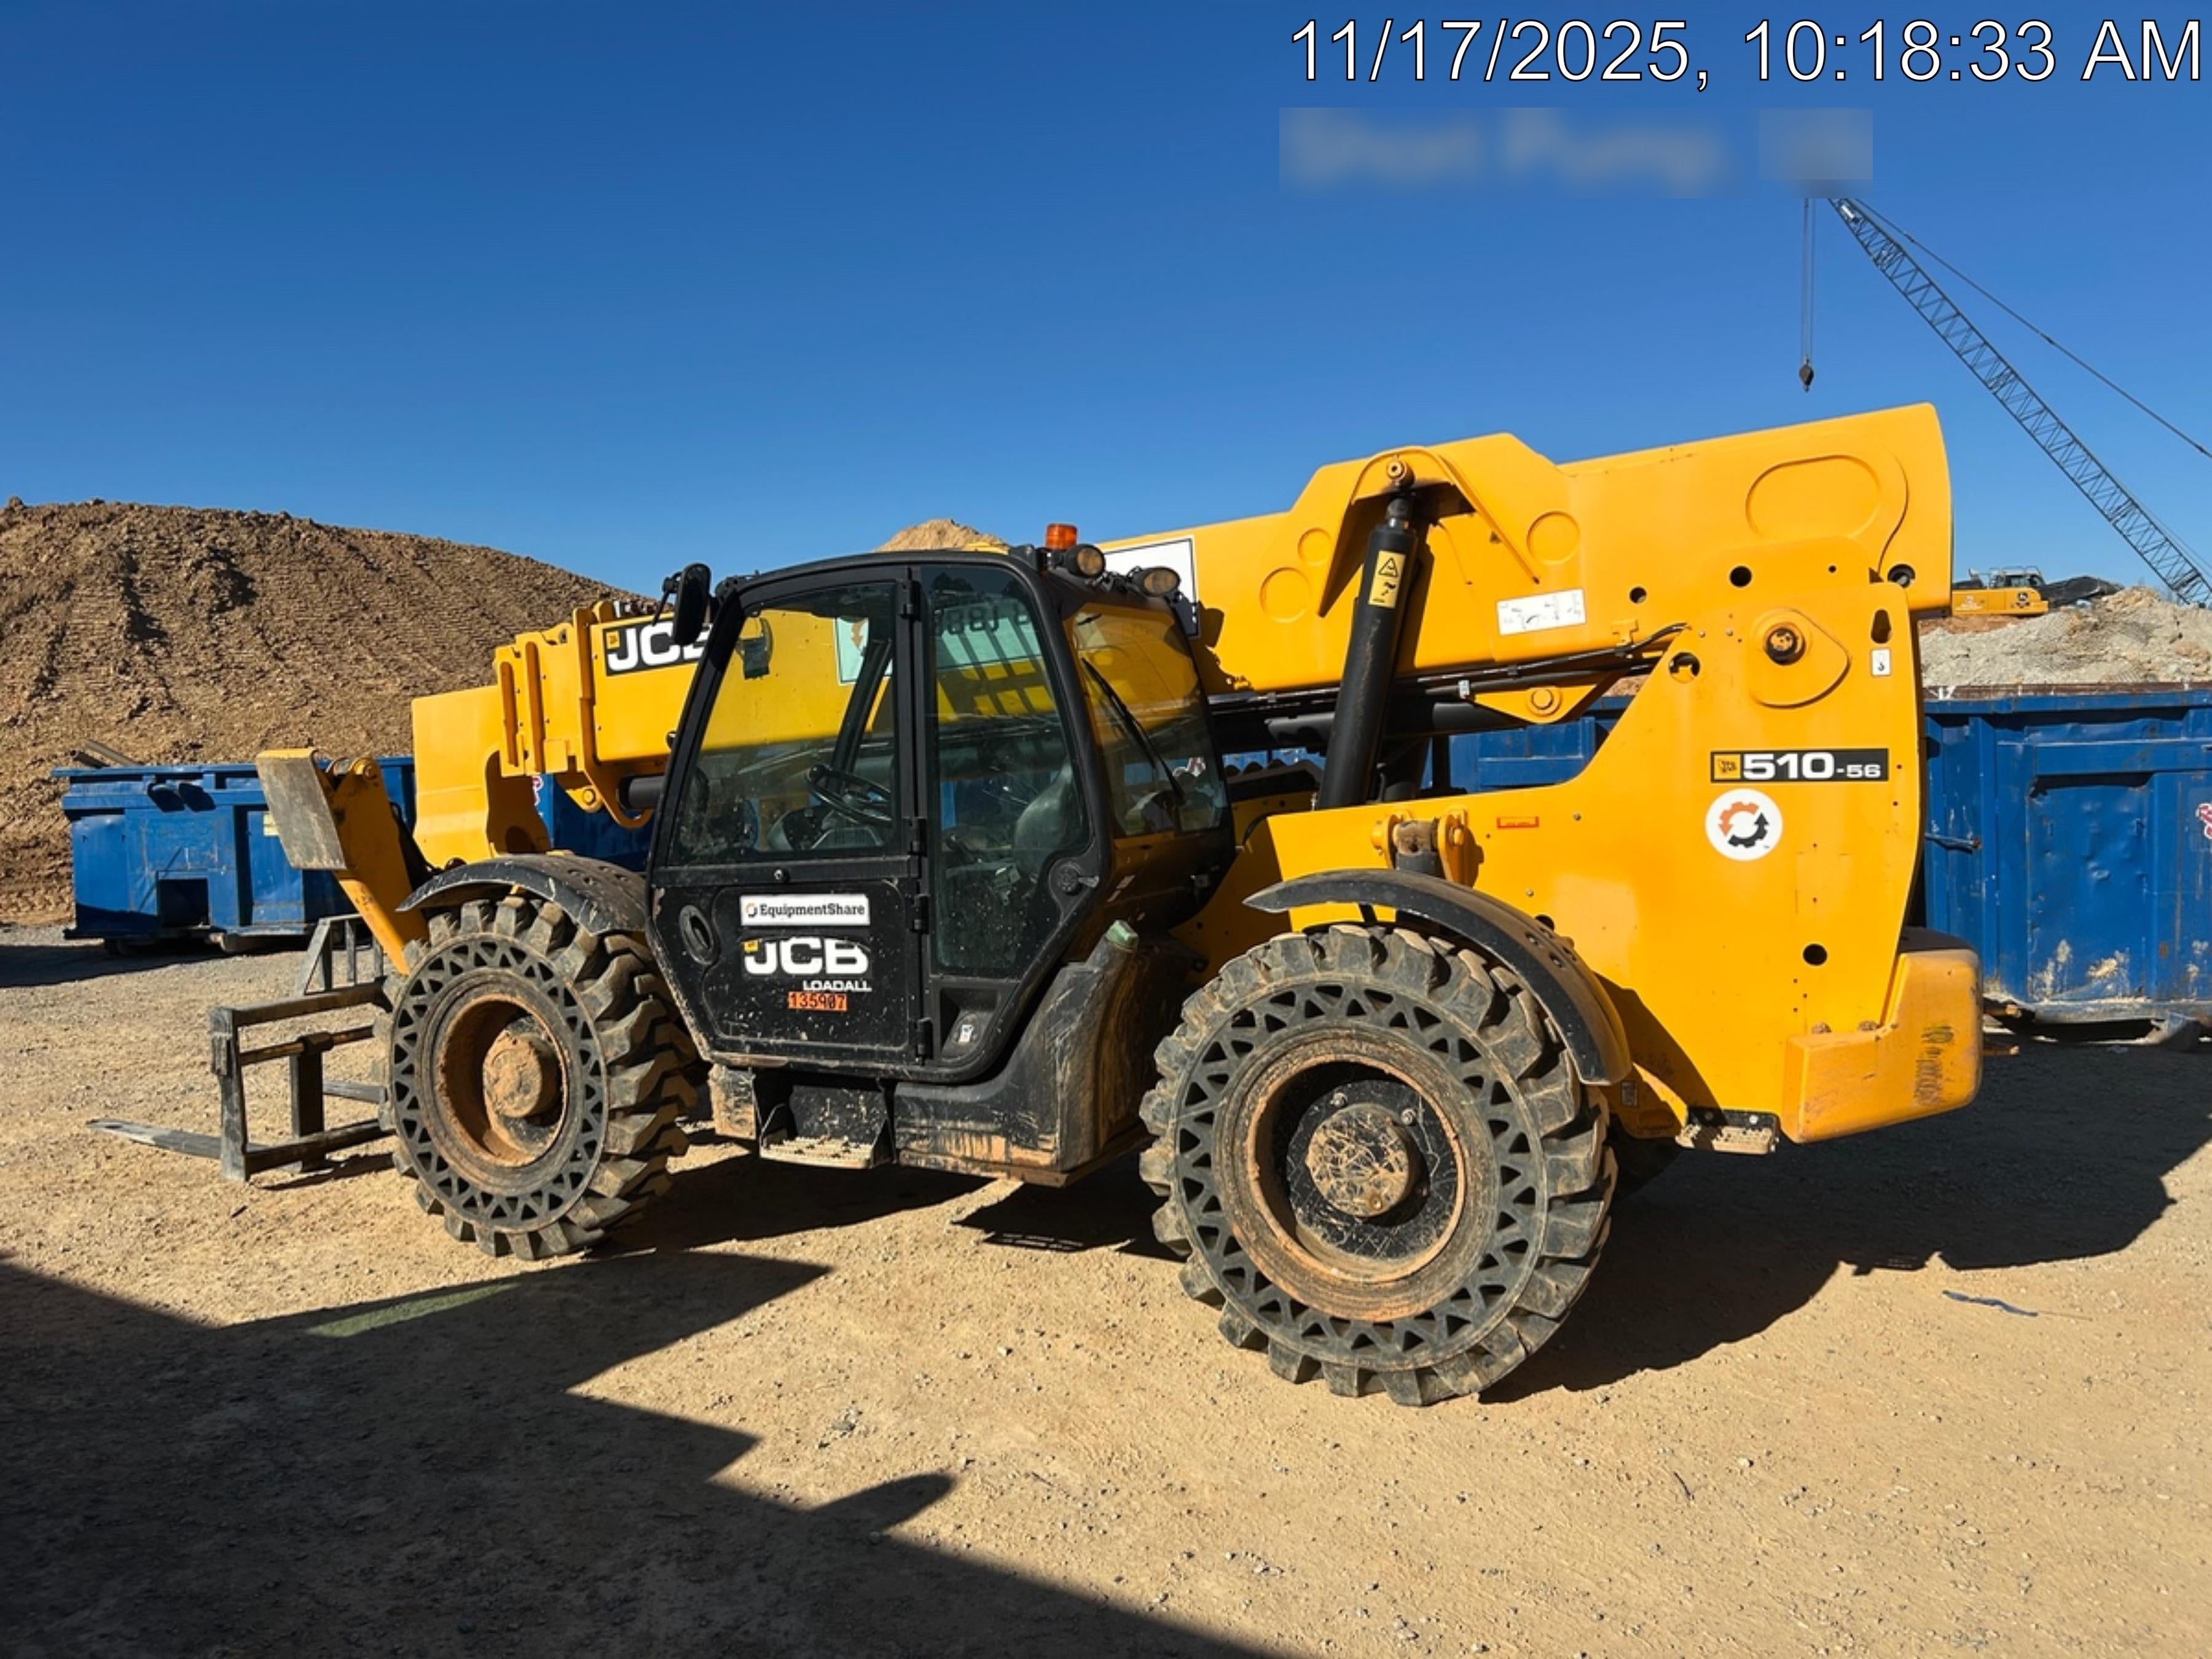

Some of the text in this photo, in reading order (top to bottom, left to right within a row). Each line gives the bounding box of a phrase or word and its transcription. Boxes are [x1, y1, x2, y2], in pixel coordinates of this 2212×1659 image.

[1743, 751, 1881, 780] 510-56
[759, 903, 865, 918] EquipmentShare
[744, 937, 869, 975] JCB
[802, 980, 873, 992] LOADALL
